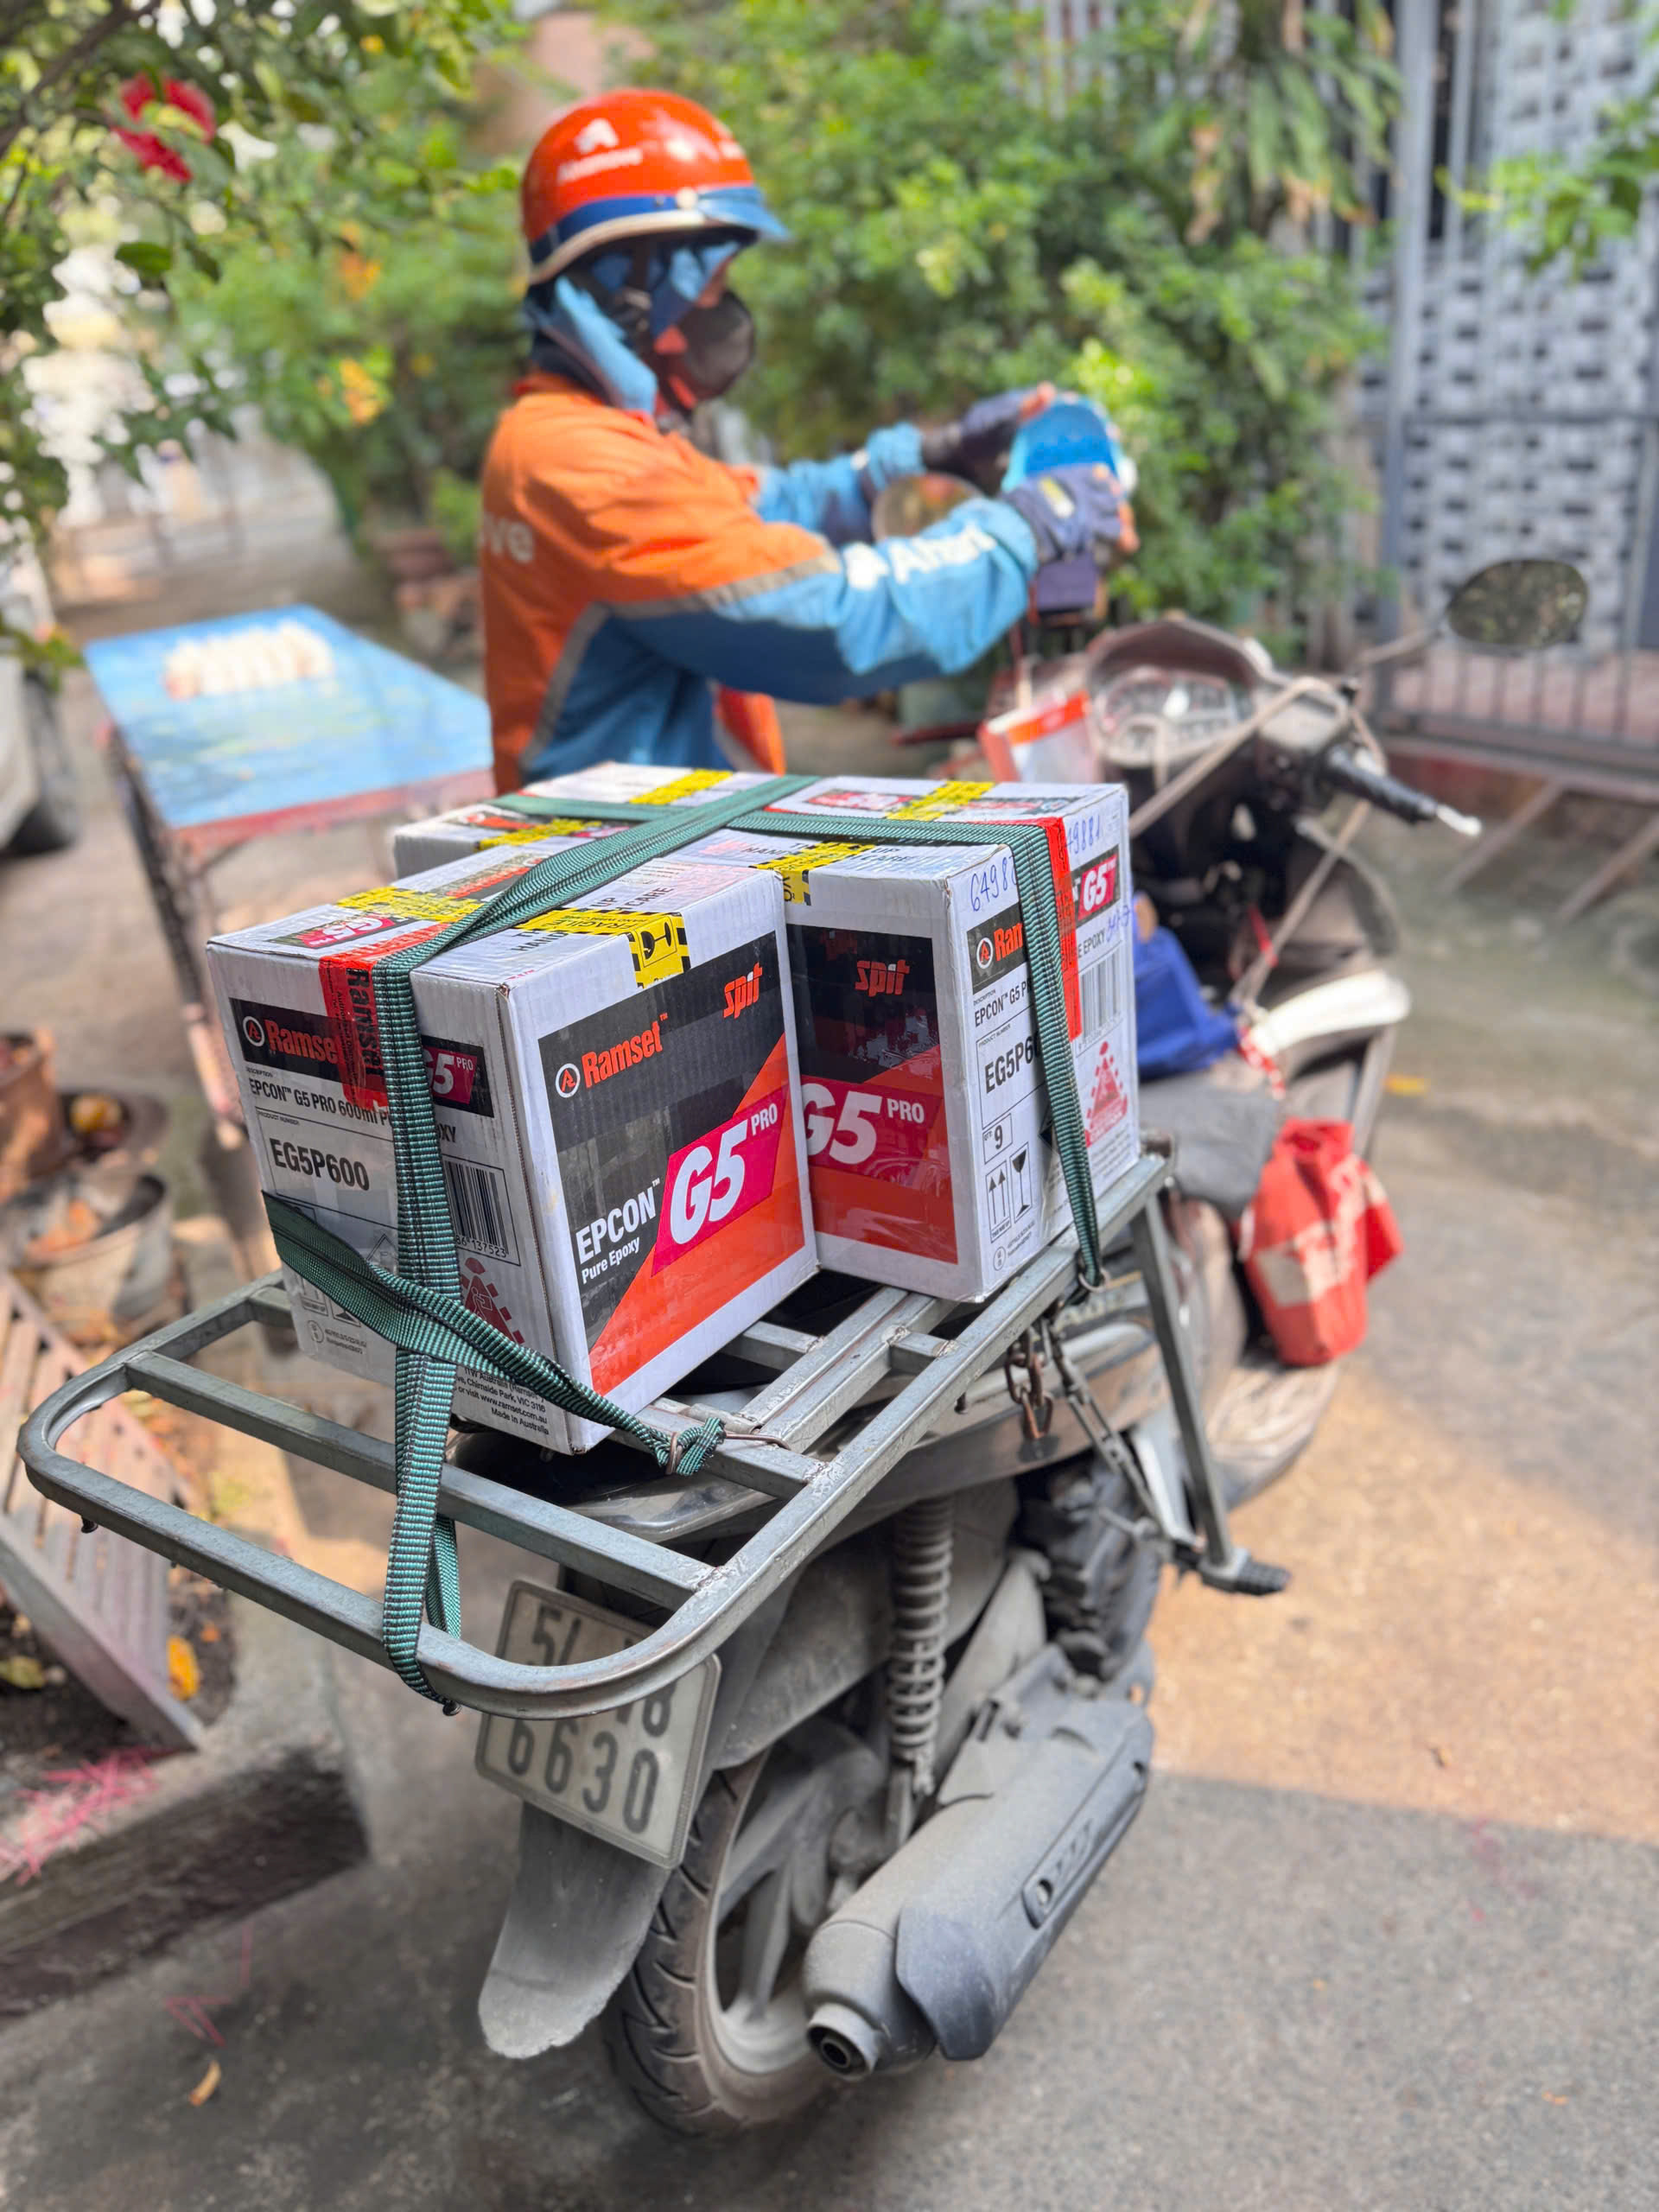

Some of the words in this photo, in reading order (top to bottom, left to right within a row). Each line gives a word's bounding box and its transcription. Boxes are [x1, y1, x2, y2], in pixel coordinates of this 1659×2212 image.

[1083, 863, 1107, 912] G5
[722, 961, 765, 1019] spit
[855, 959, 911, 998] spit
[1009, 986, 1020, 1005] G5
[456, 1057, 474, 1071] PRO
[294, 1089, 311, 1108] G5
[312, 1094, 337, 1114] PRO
[801, 1083, 883, 1165] G5
[887, 1097, 925, 1124] PRO
[995, 1124, 1003, 1150] 9
[270, 1138, 370, 1192] EG5P600
[670, 1118, 749, 1245] G5
[751, 1103, 778, 1138] PRO
[582, 1255, 608, 1285] Pure
[609, 1236, 640, 1273] Epoxy
[491, 1407, 512, 1421] Made
[519, 1417, 550, 1435] Australia
[508, 1719, 659, 1834] 6630
